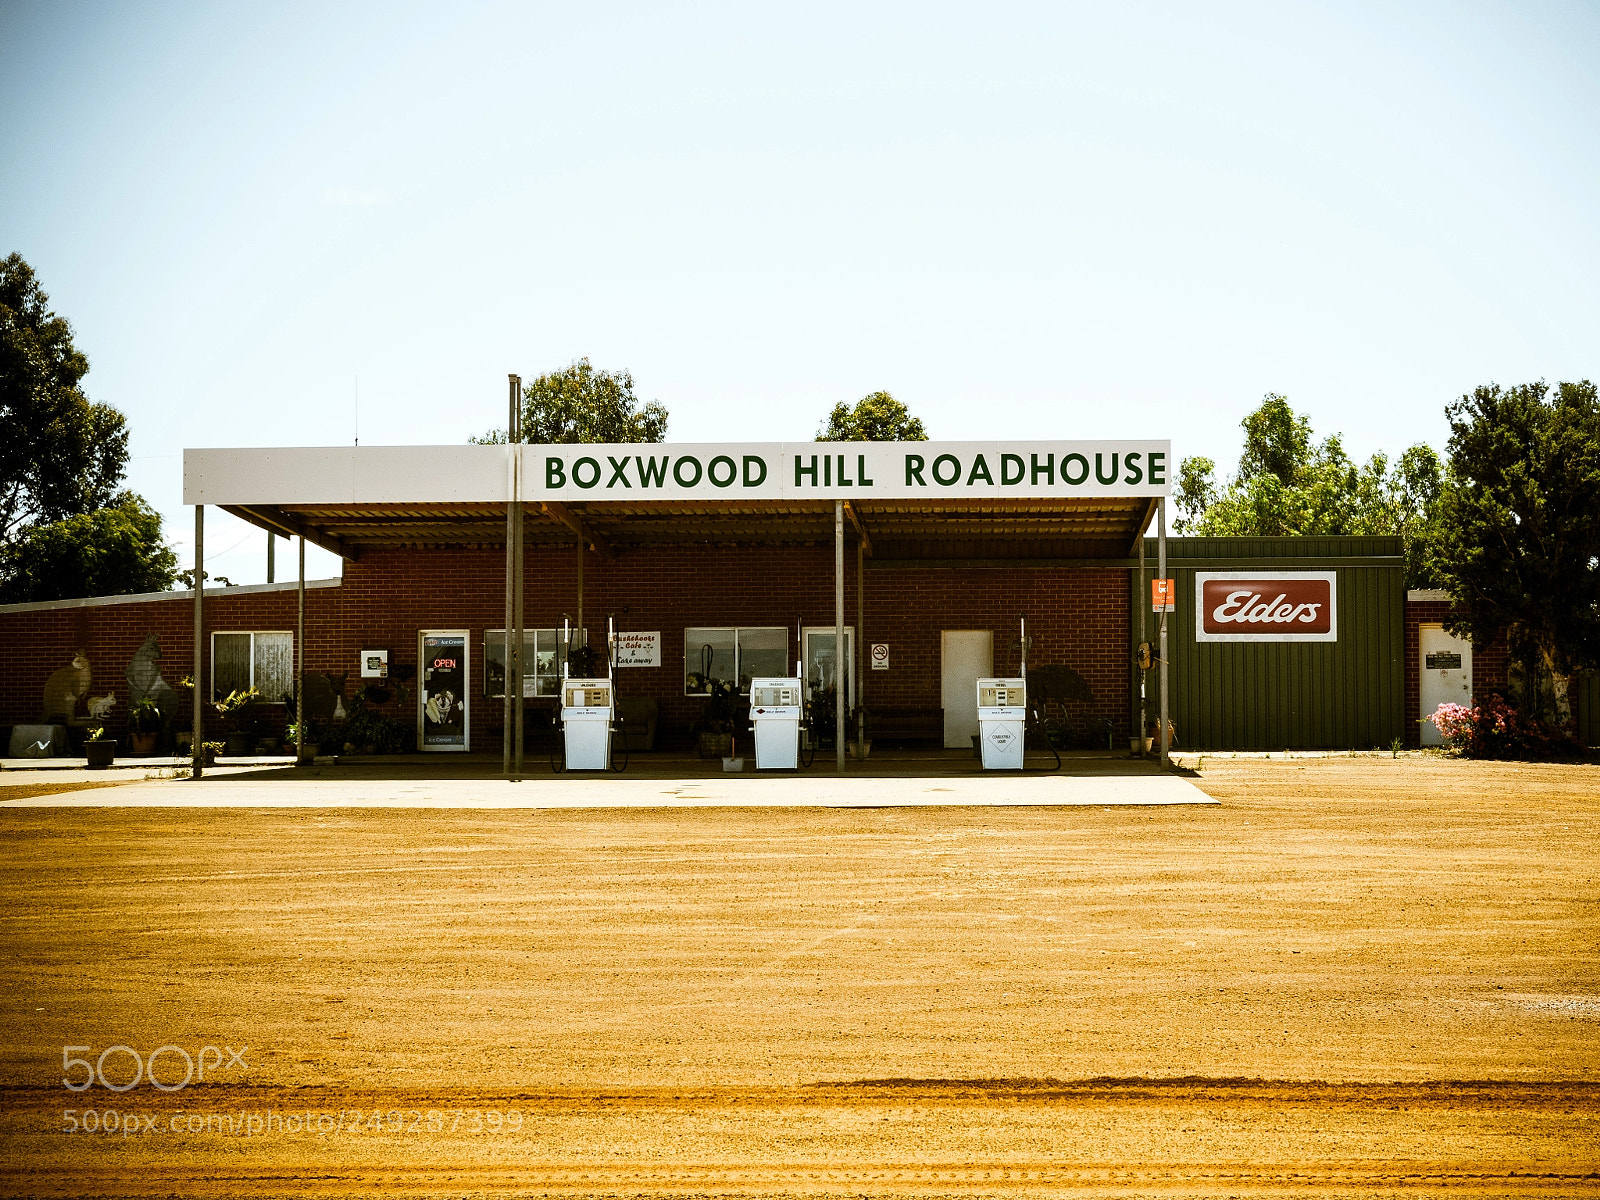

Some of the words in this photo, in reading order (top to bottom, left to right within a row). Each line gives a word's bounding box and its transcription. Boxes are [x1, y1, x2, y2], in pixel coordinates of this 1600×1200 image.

[545, 456, 768, 490] BOXWOOD
[794, 454, 874, 487] HILL
[905, 452, 1166, 487] ROADHOUSE
[1212, 590, 1322, 624] Elders
[434, 658, 457, 668] OPEN
